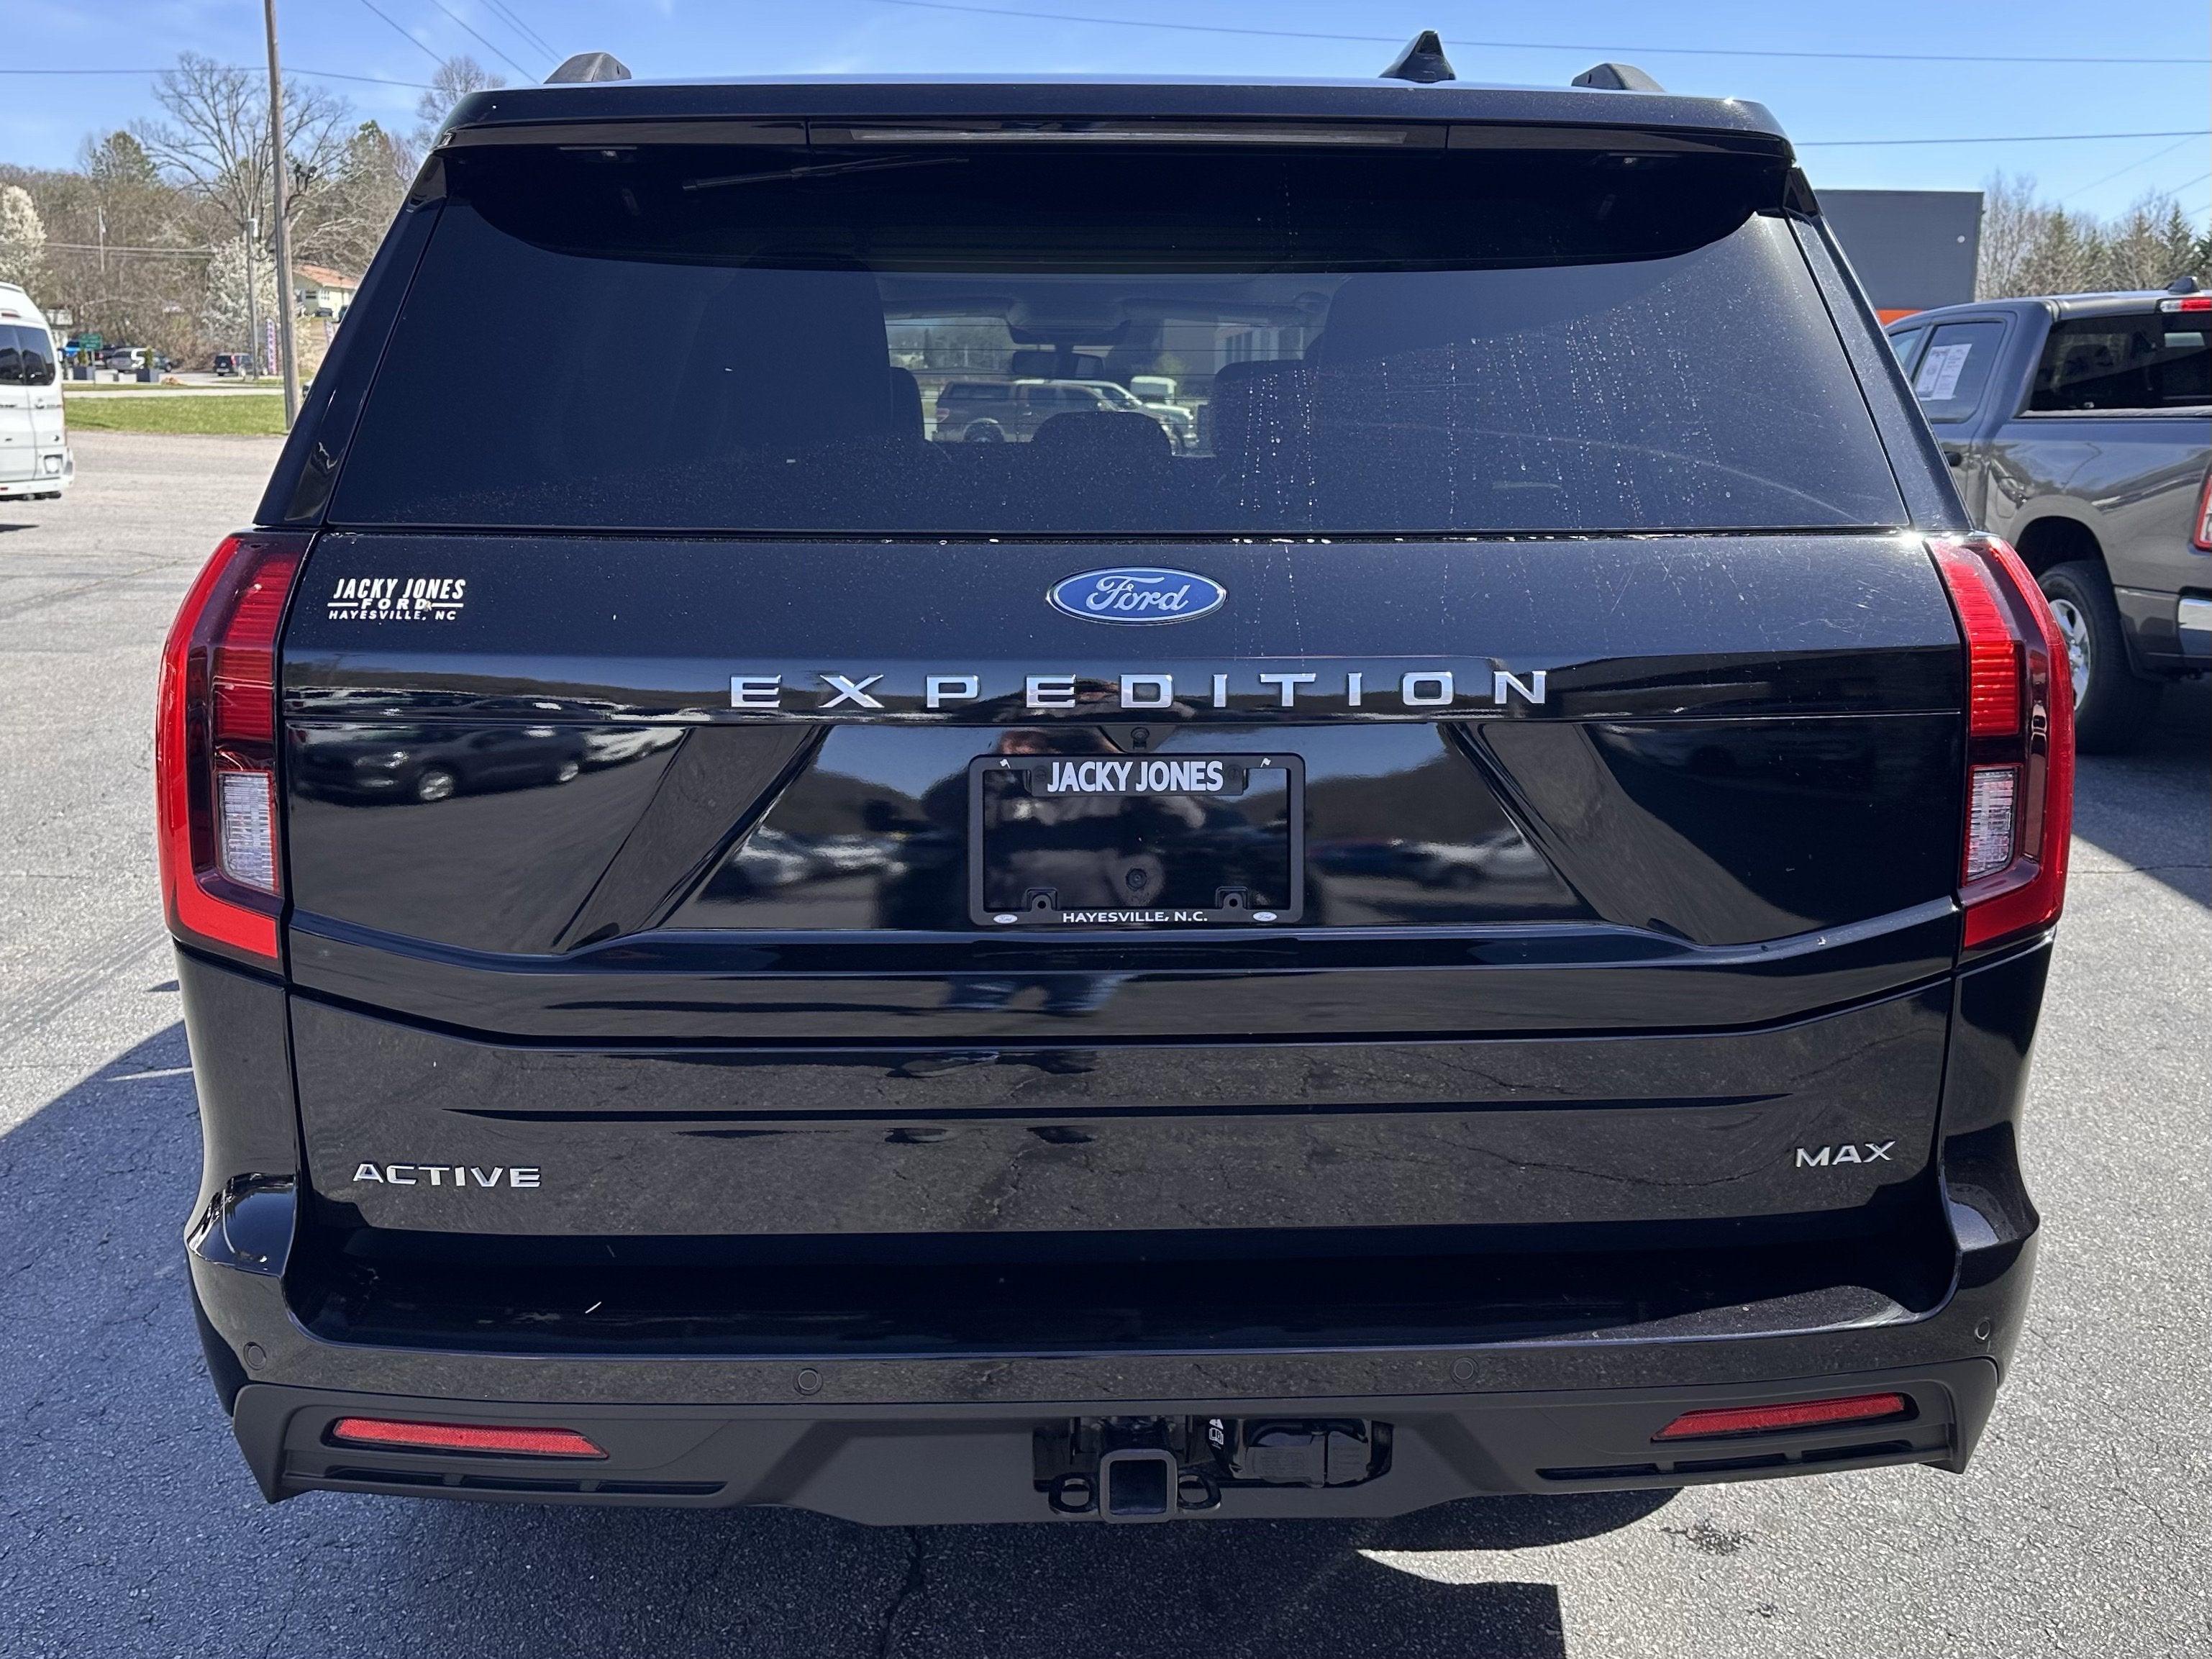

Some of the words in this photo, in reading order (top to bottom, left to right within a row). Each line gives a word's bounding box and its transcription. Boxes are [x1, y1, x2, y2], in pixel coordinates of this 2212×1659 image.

[333, 578, 399, 599] JACKY
[402, 578, 466, 599] JONES
[1085, 576, 1191, 611] Ford
[328, 610, 427, 621] HAYESVILLE,
[434, 611, 456, 620] NC
[361, 599, 427, 610] FORD
[730, 671, 1547, 708] EXPEDITION
[1047, 761, 1133, 792] JACKY
[1136, 760, 1224, 791] JONES
[1062, 912, 1170, 922] HAYESVILLE,
[1174, 911, 1209, 922] N.C.
[1795, 1140, 1896, 1168] MAX
[352, 1163, 541, 1187] ACTIVE
